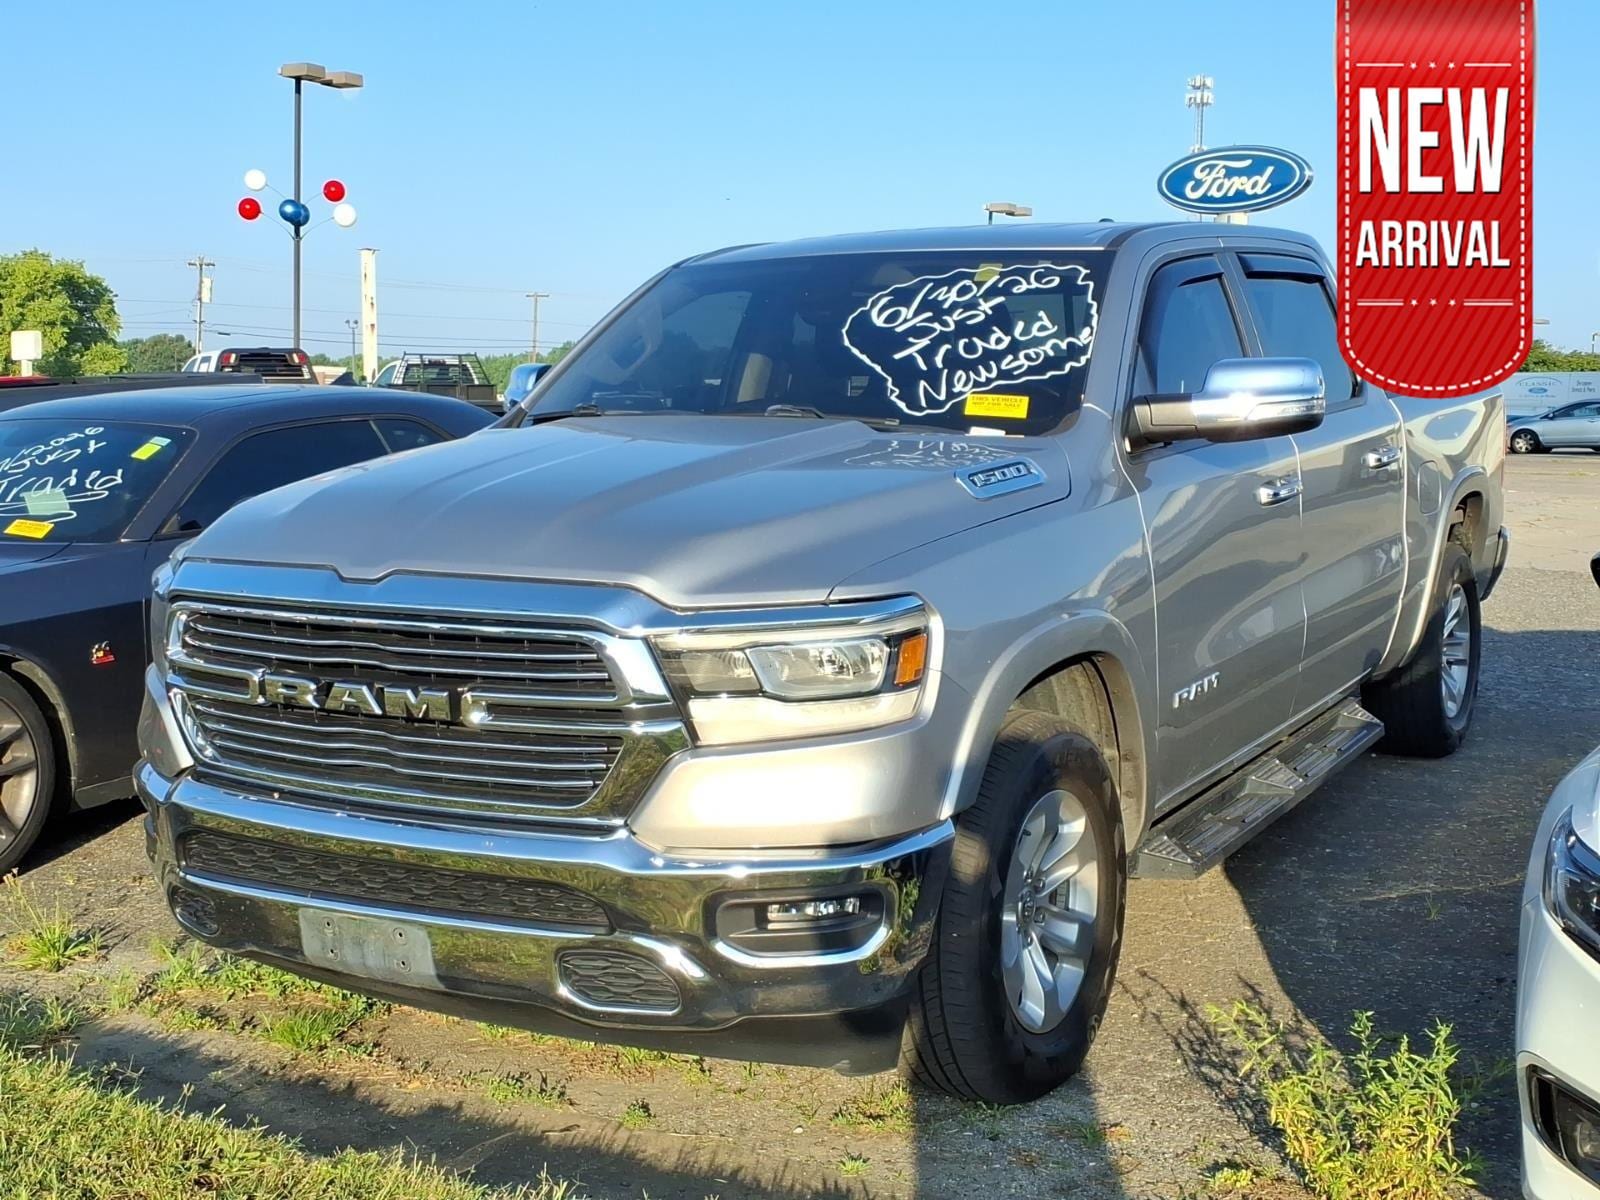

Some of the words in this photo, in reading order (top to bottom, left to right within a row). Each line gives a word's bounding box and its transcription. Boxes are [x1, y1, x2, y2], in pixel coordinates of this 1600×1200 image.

[1185, 159, 1274, 199] Ford
[893, 310, 1058, 371] Traded
[894, 296, 1006, 343] Just
[970, 463, 1028, 488] 1500
[265, 672, 451, 721] RAM
[1172, 671, 1220, 708] RAM
